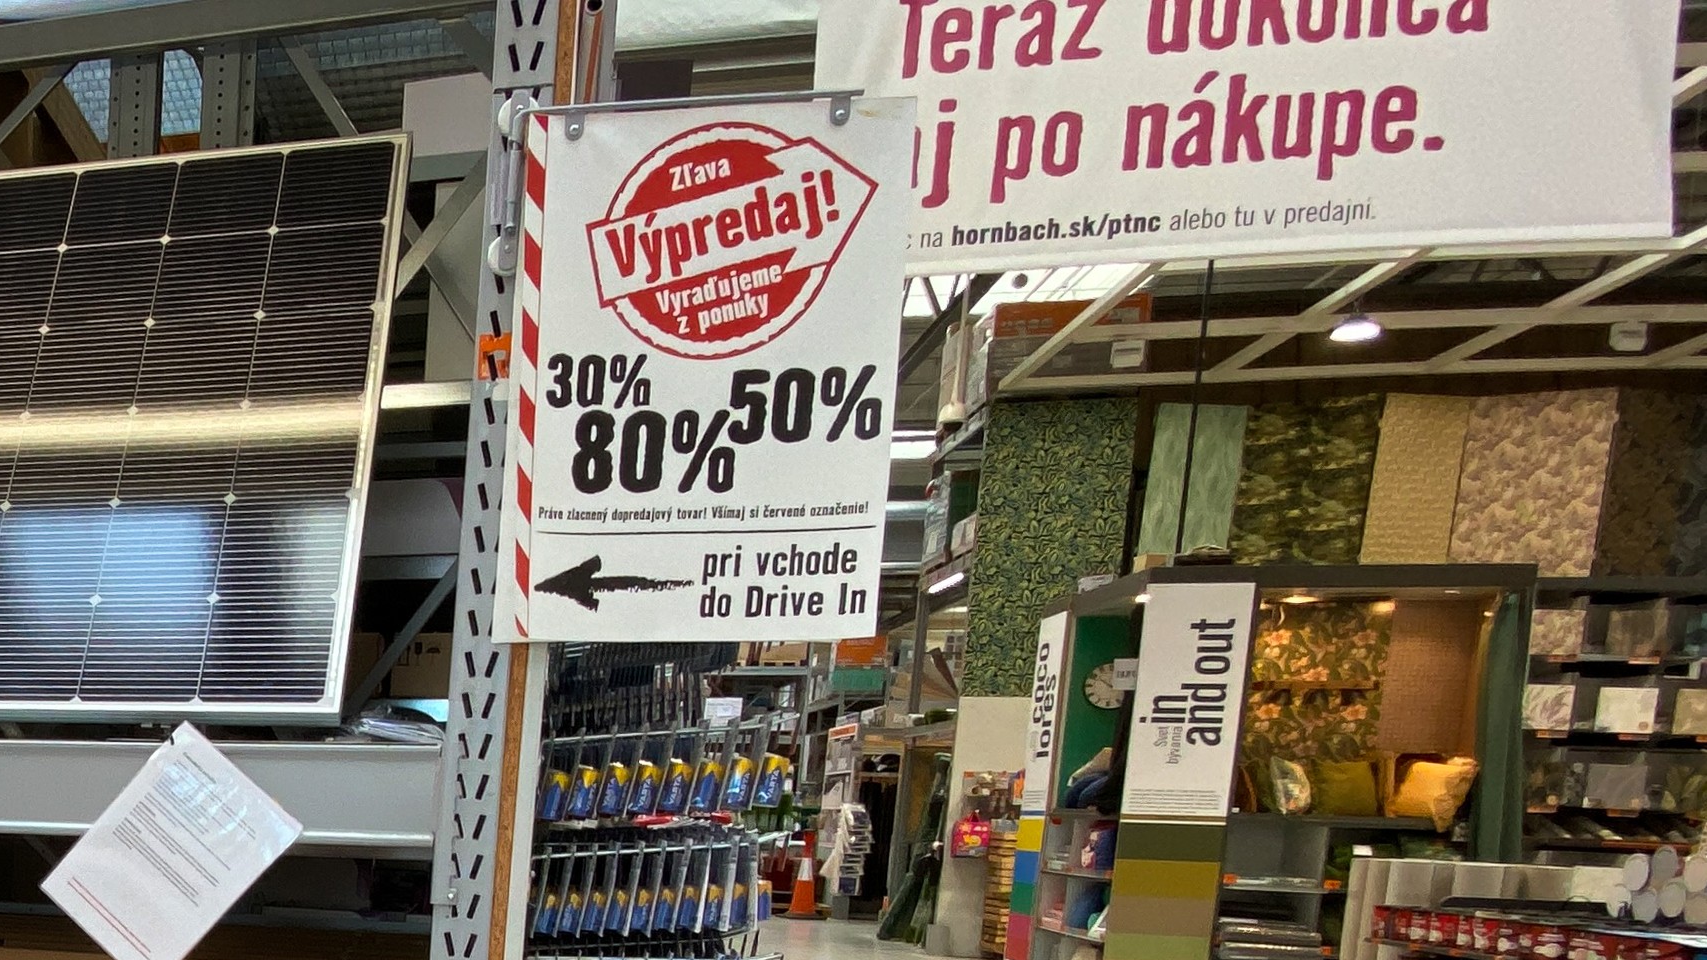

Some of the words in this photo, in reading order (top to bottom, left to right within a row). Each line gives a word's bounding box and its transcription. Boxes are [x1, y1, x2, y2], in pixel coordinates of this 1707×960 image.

[898, 0, 1107, 79] Teraz
[989, 111, 1083, 204] po
[1121, 70, 1445, 181] nákupe.
[668, 156, 731, 193] Zľava
[604, 168, 840, 283] Výpredaj!
[920, 229, 943, 248] na
[951, 213, 1161, 246] hornbach.sk/ptnc
[1169, 209, 1226, 231] alebo
[1234, 206, 1255, 227] tu
[1264, 210, 1276, 225] v
[654, 262, 783, 317] Vyraďujeme
[677, 315, 689, 334] z
[698, 293, 769, 334] ponuky
[545, 352, 651, 410] 30%
[728, 364, 882, 445] 50%
[572, 409, 736, 493] 80%
[538, 506, 563, 520] Práve
[567, 507, 608, 523] zlacnený
[611, 506, 672, 523] dopredajový
[677, 506, 707, 520] tovar!
[712, 504, 745, 521] Všímaj
[749, 505, 759, 518] si
[763, 503, 805, 518] červené
[810, 501, 869, 516] označenie!
[701, 545, 742, 585] pri
[756, 542, 858, 577] vchode
[699, 586, 732, 618] do
[745, 584, 823, 618] Drive
[838, 582, 867, 615] In
[1190, 618, 1236, 675] out
[1139, 695, 1188, 723] in
[1181, 683, 1227, 746] and
[668, 774, 682, 805] VARTA
[765, 769, 780, 800] VARTA
